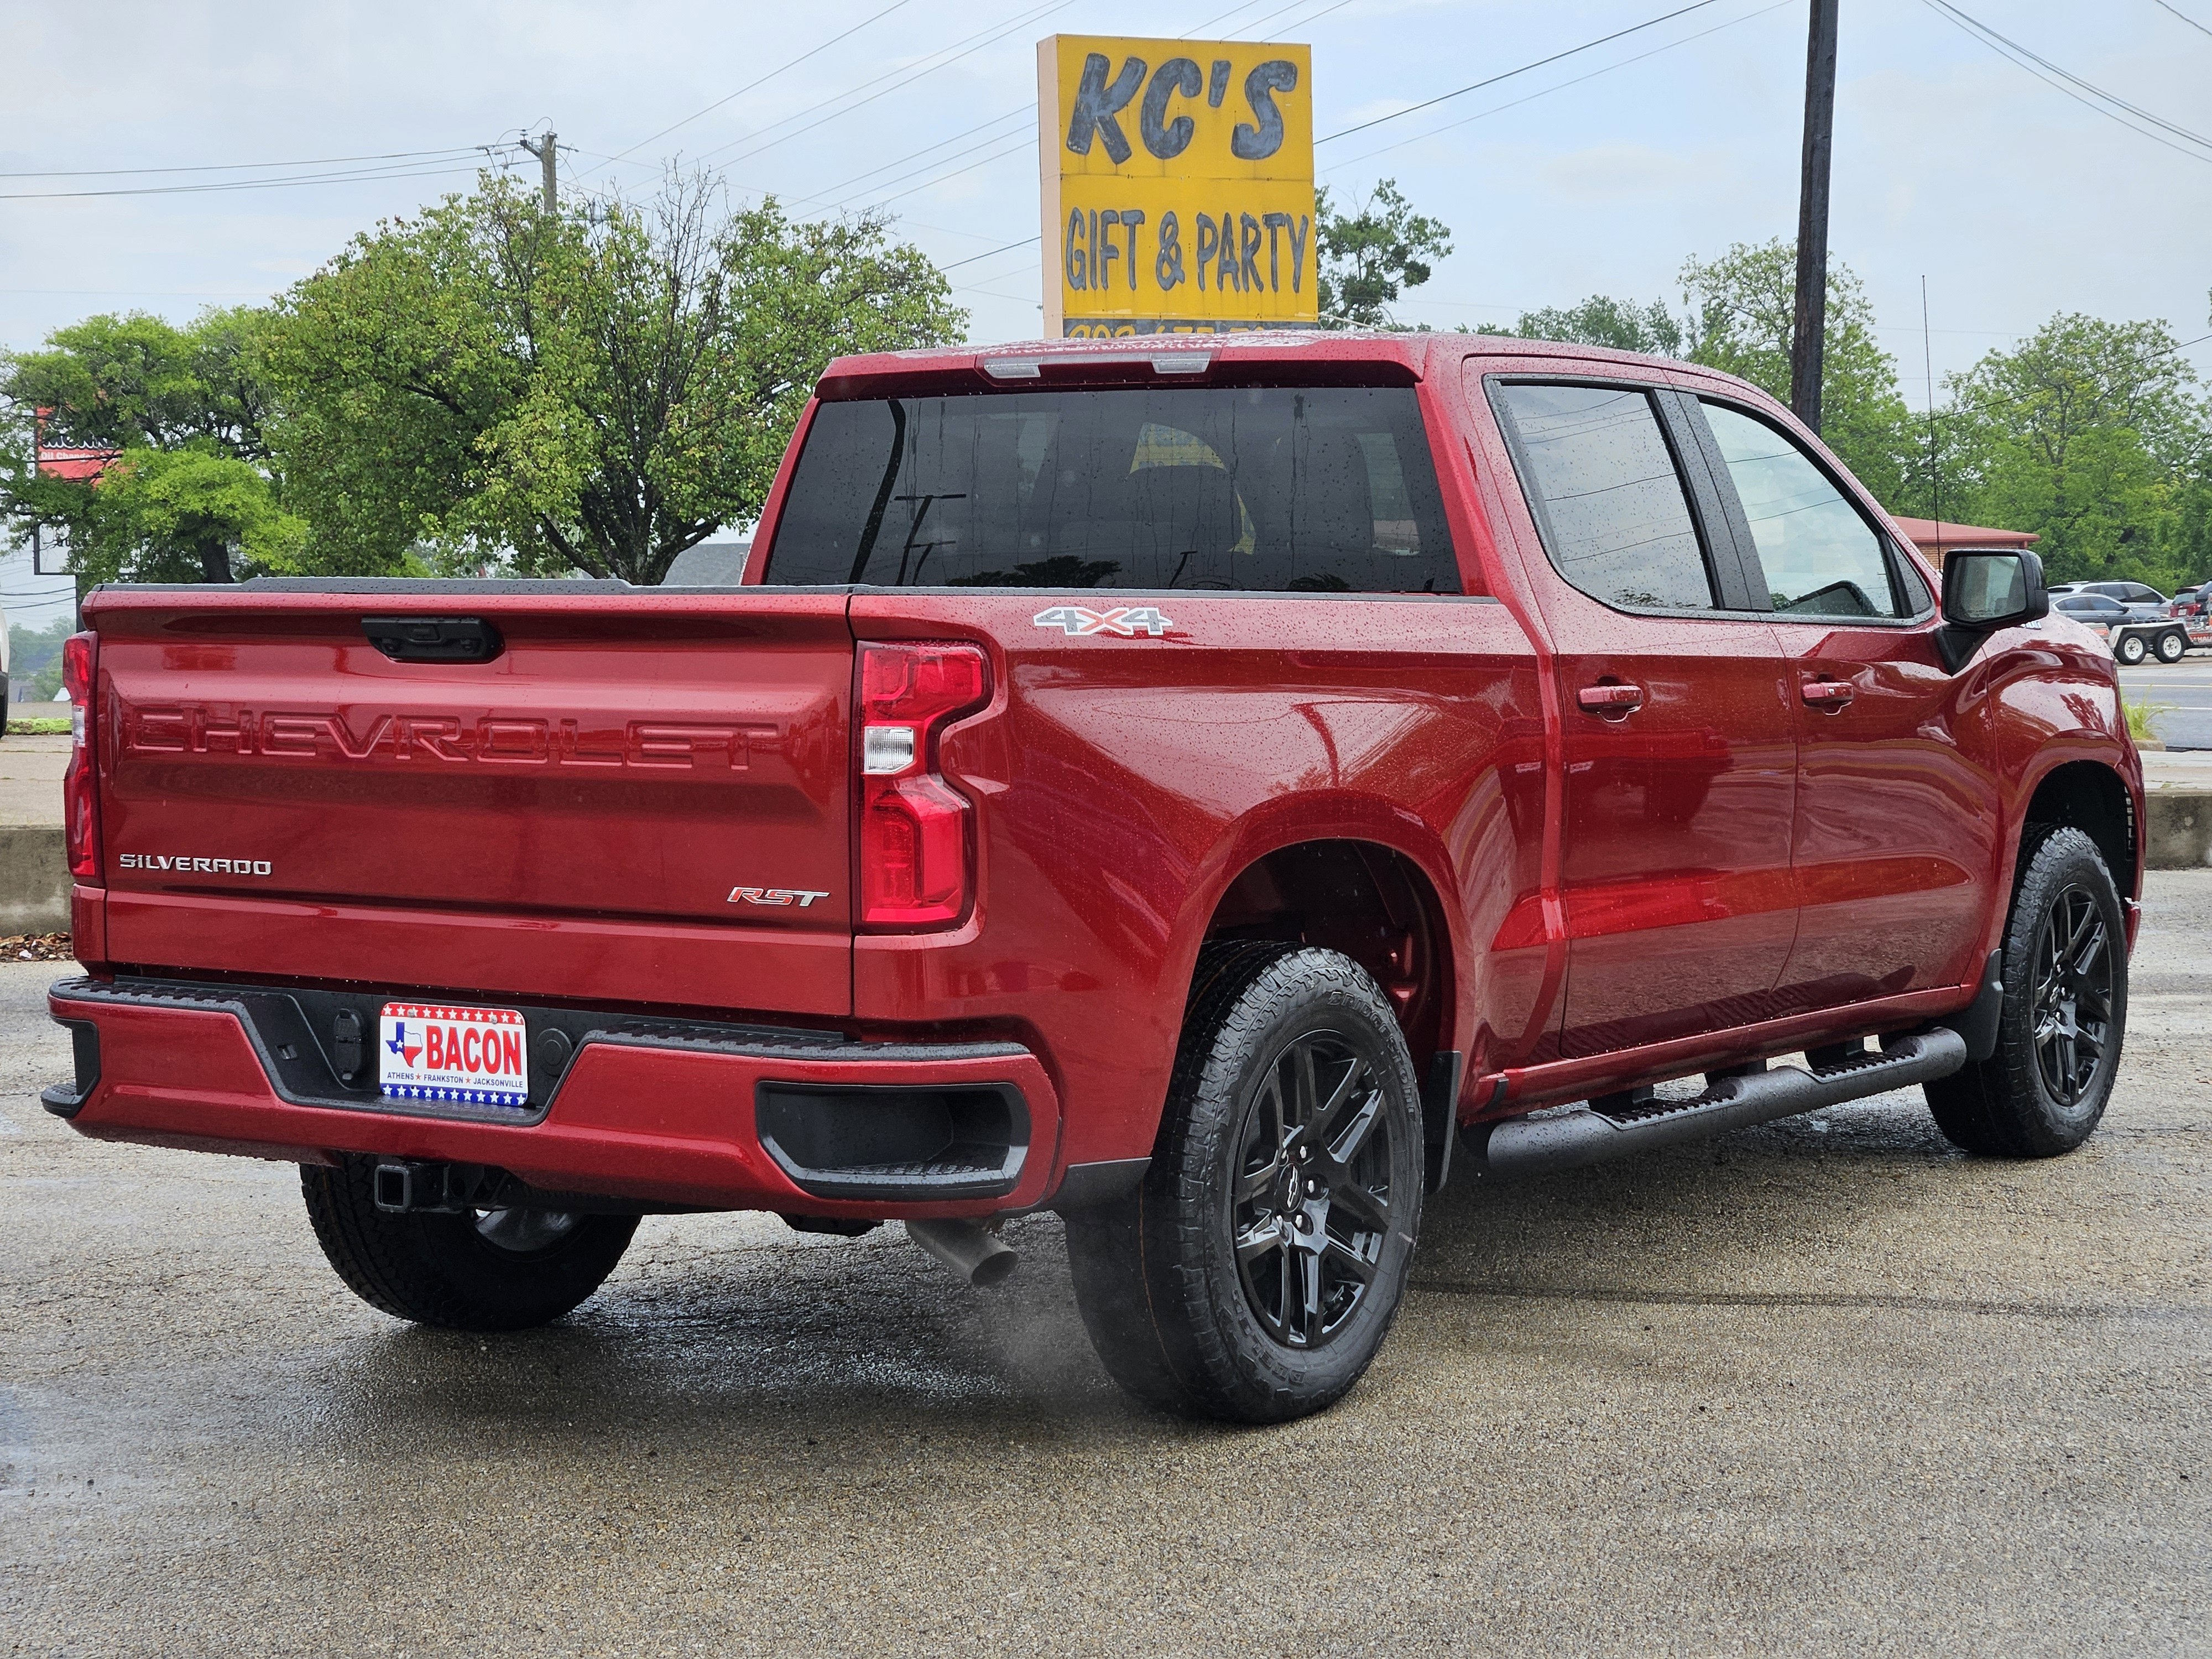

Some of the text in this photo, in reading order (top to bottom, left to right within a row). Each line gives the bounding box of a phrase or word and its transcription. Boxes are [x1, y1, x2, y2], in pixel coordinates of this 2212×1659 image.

[1066, 53, 1298, 165] KC'S
[1066, 207, 1309, 293] GIFT & PARTY
[131, 709, 779, 770] CHEVROLET
[118, 853, 272, 875] SILVERADO
[727, 886, 830, 907] RST
[426, 1025, 521, 1076] BACON
[387, 1072, 523, 1088] ATHENS FRANKSTON JACKSONVILLE
